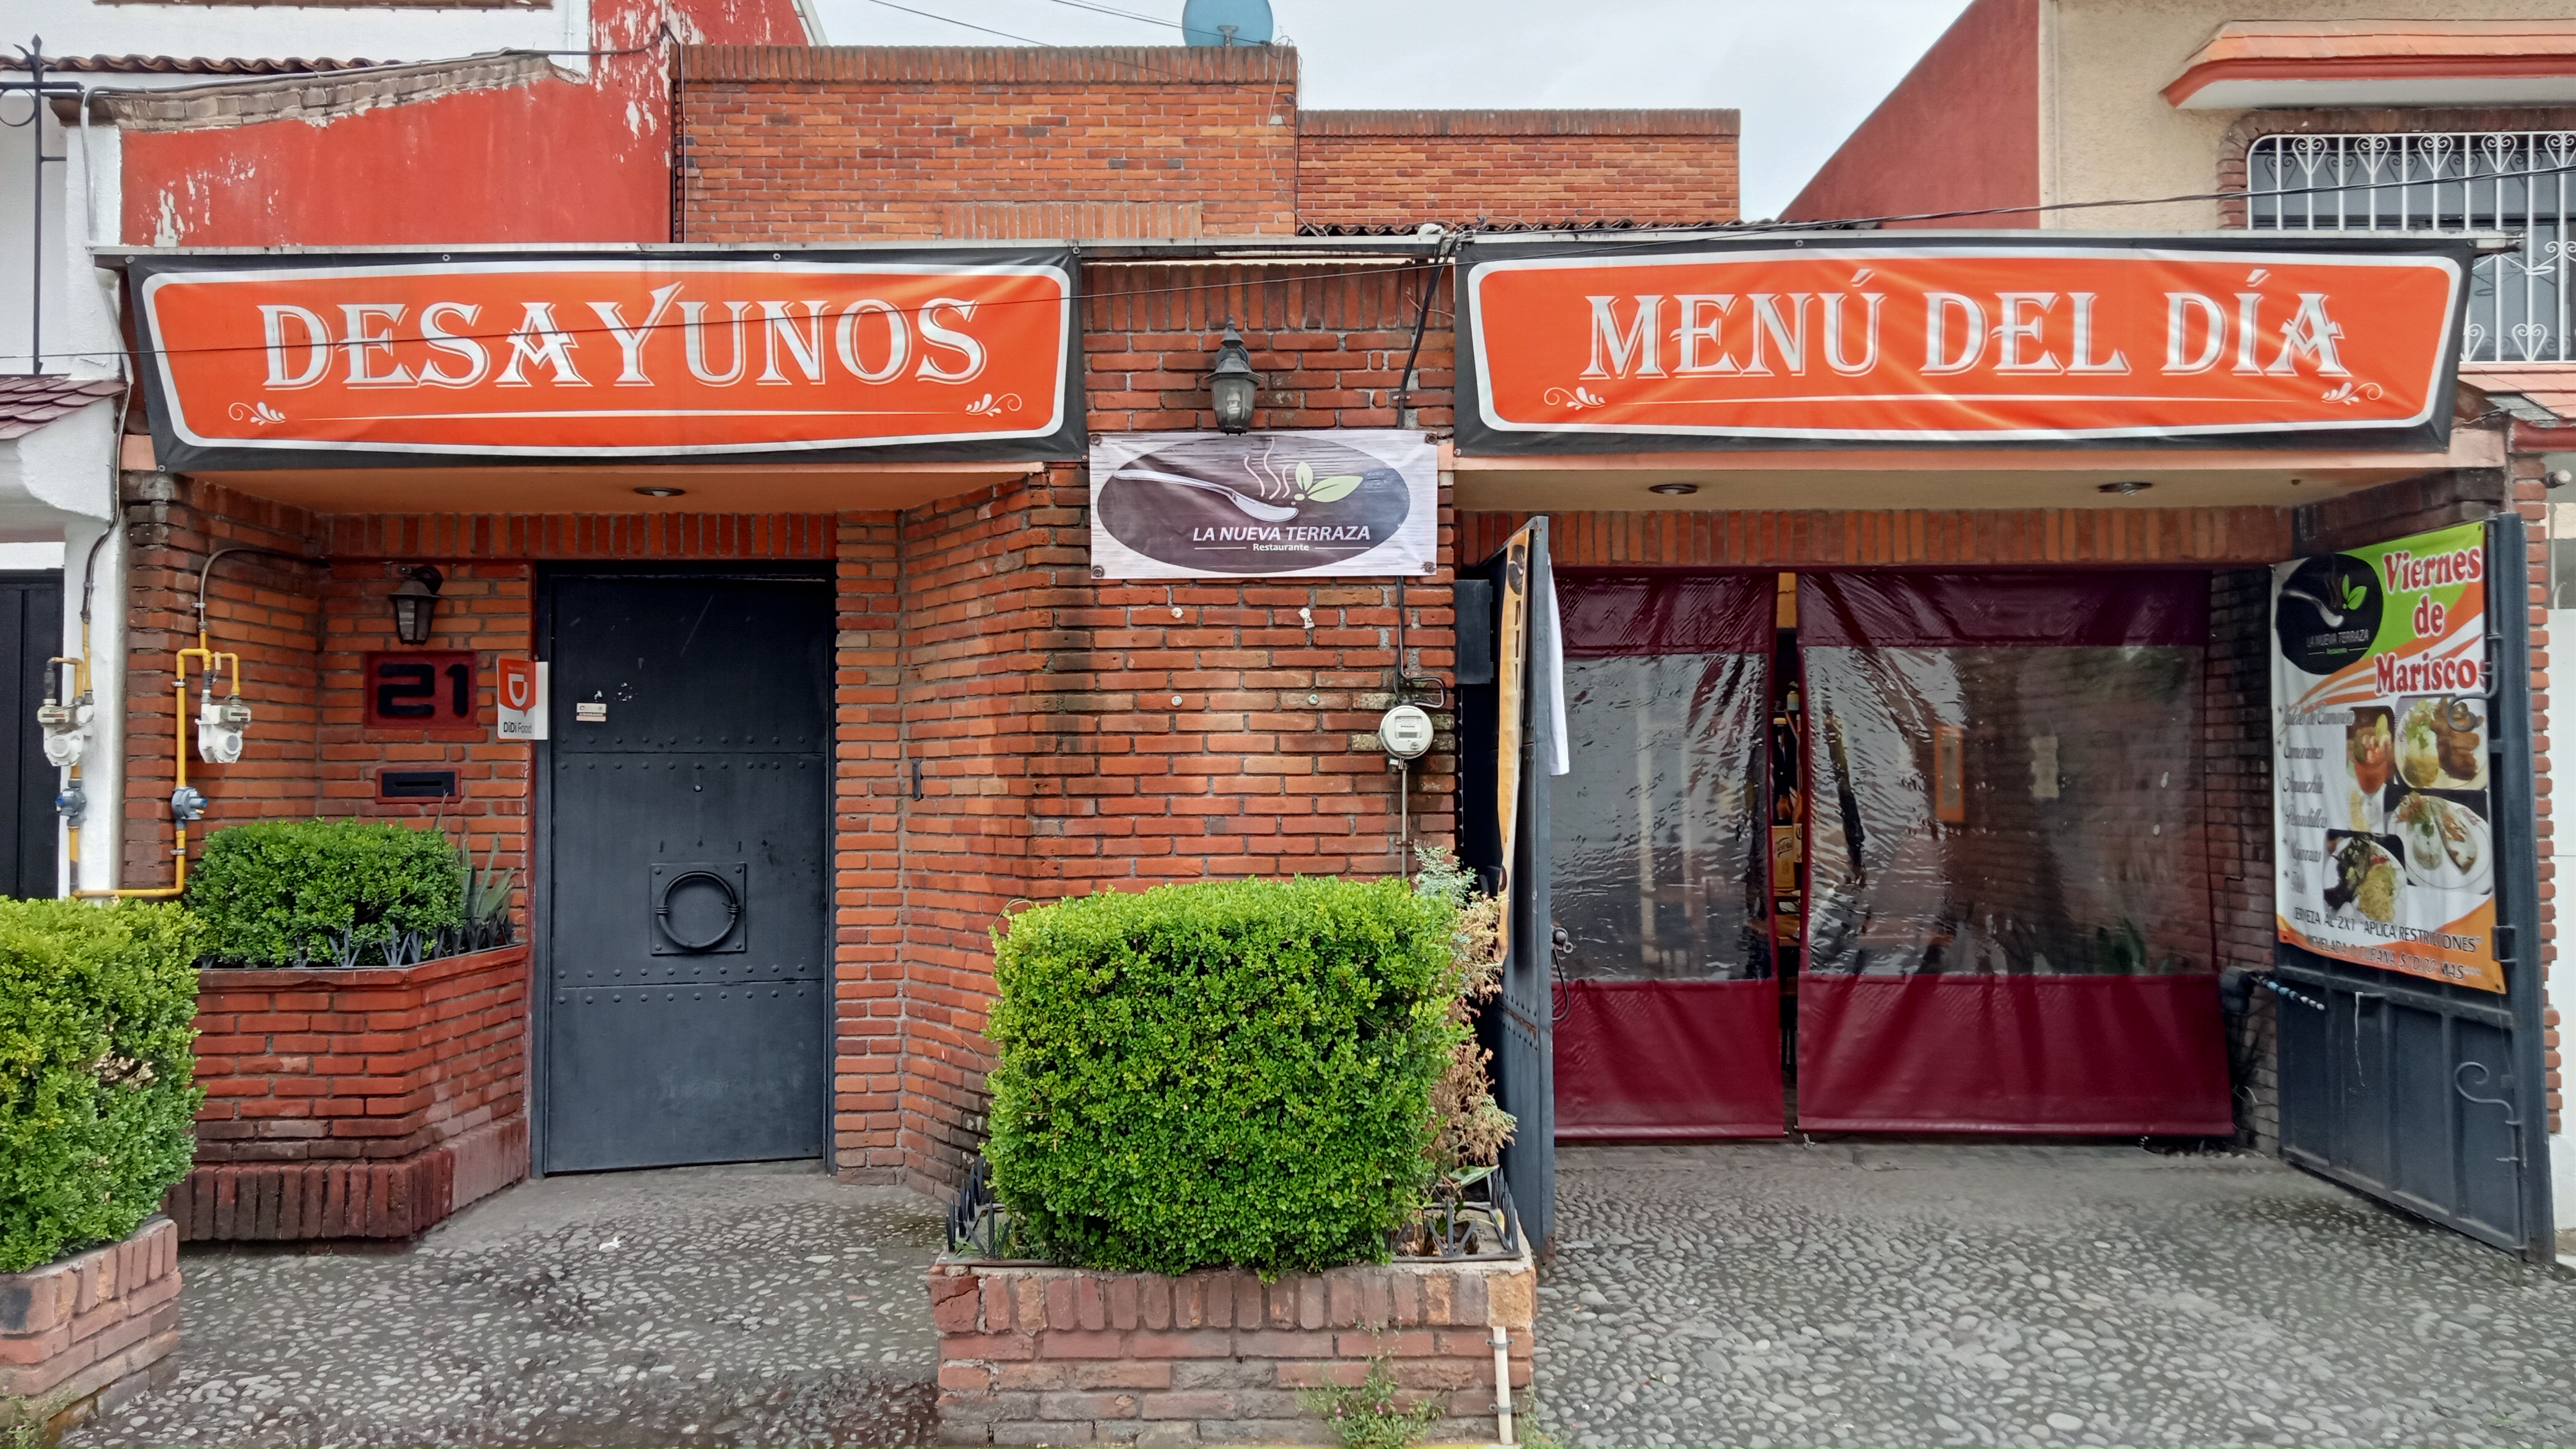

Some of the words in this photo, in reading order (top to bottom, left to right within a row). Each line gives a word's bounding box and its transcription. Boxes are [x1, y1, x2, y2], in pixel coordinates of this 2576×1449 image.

[256, 280, 987, 391] DESAYUNOS
[1579, 268, 1887, 382] MENÚ
[1920, 291, 2133, 380] DEL
[2161, 268, 2356, 380] DÍA
[1193, 528, 1216, 542] LA
[1219, 526, 1281, 542] NUEVA
[1286, 525, 1371, 541] TERRAZA
[1253, 543, 1310, 552] Restaurante
[2383, 547, 2482, 593] Viernes
[2414, 595, 2444, 637] de
[378, 663, 469, 717] 21
[503, 722, 517, 733] DiDi
[518, 722, 531, 733] Food
[2294, 907, 2321, 925] ERVEZA
